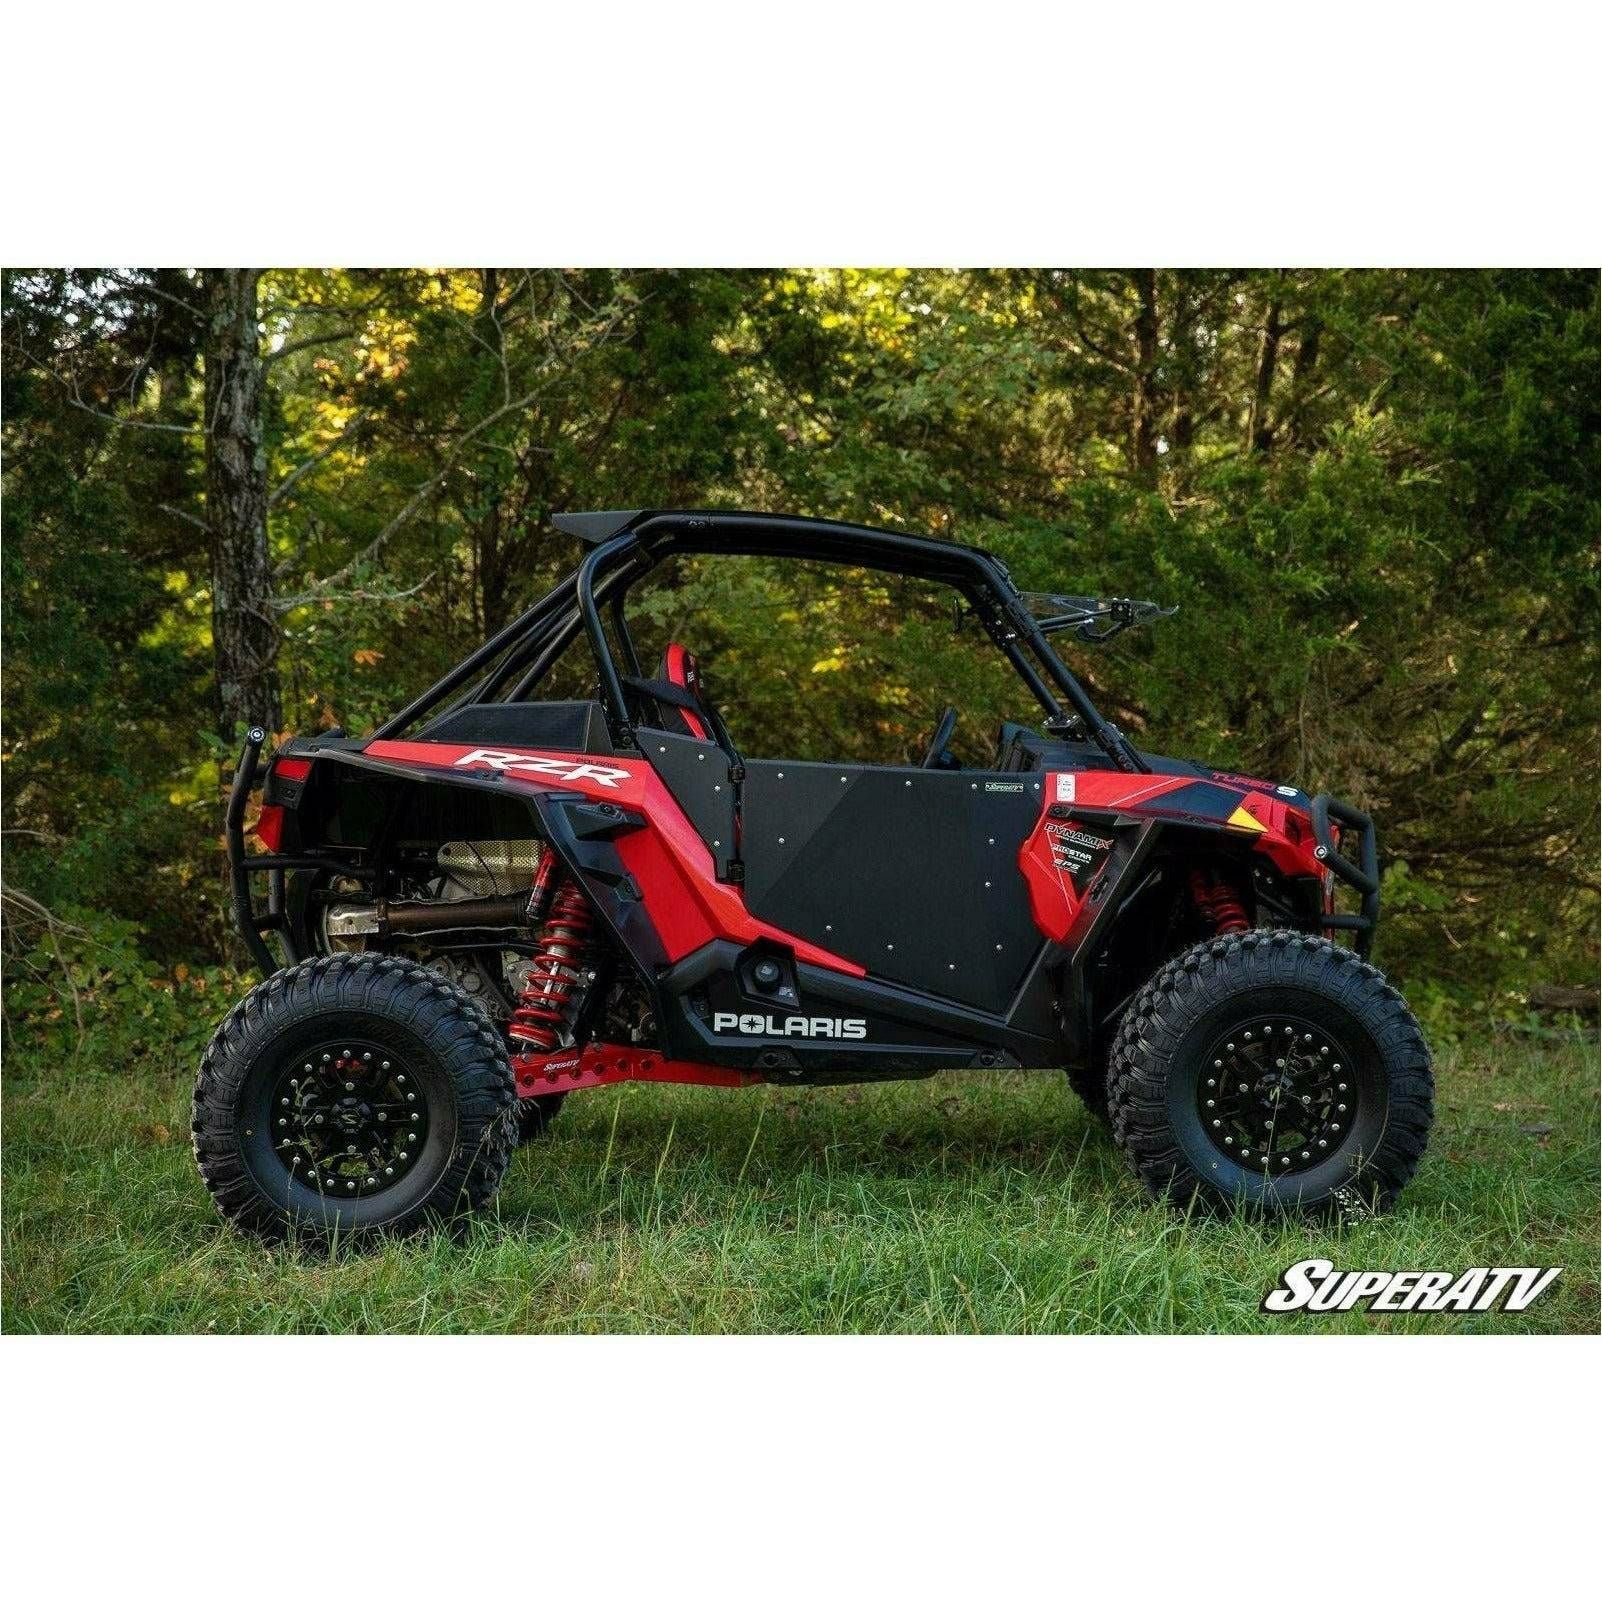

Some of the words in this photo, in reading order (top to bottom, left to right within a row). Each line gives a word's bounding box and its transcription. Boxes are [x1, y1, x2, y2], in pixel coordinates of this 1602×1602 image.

[453, 749, 633, 788] RZR
[1044, 822, 1114, 850] DYNAMIX
[714, 1012, 867, 1039] POLARIS
